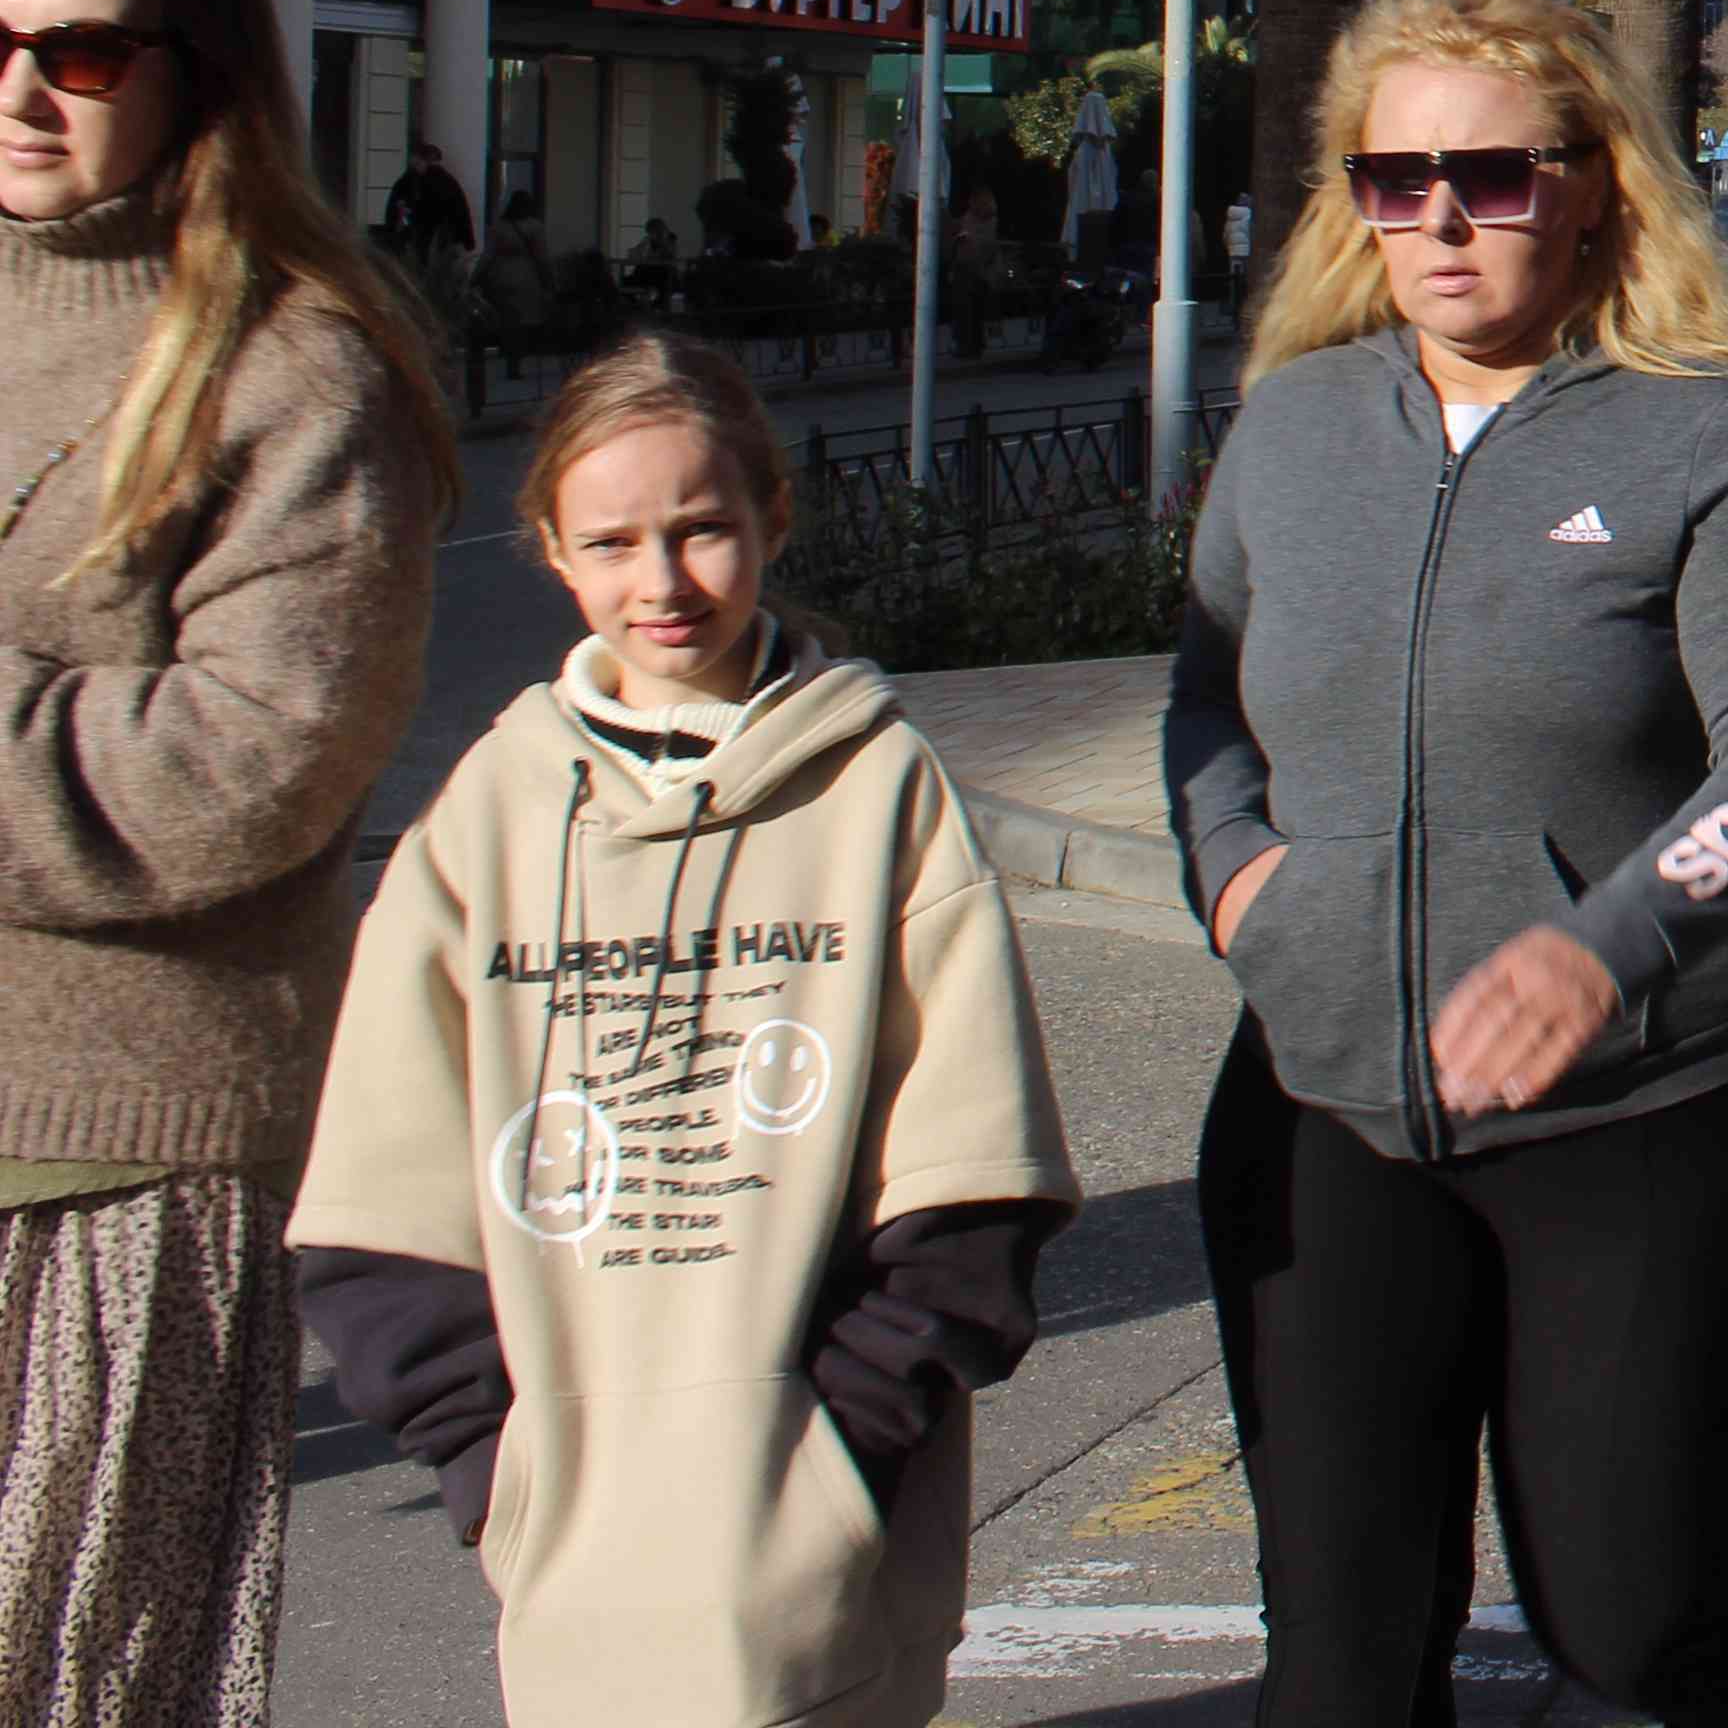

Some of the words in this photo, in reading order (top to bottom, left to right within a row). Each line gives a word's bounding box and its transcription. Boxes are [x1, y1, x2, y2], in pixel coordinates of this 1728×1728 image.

[1548, 528, 1613, 544] adidas
[486, 940, 556, 983] ALL
[559, 927, 720, 982] PEOPLE
[732, 921, 848, 967] HAVE
[597, 1028, 639, 1057] ARE
[600, 1247, 645, 1269] ARE
